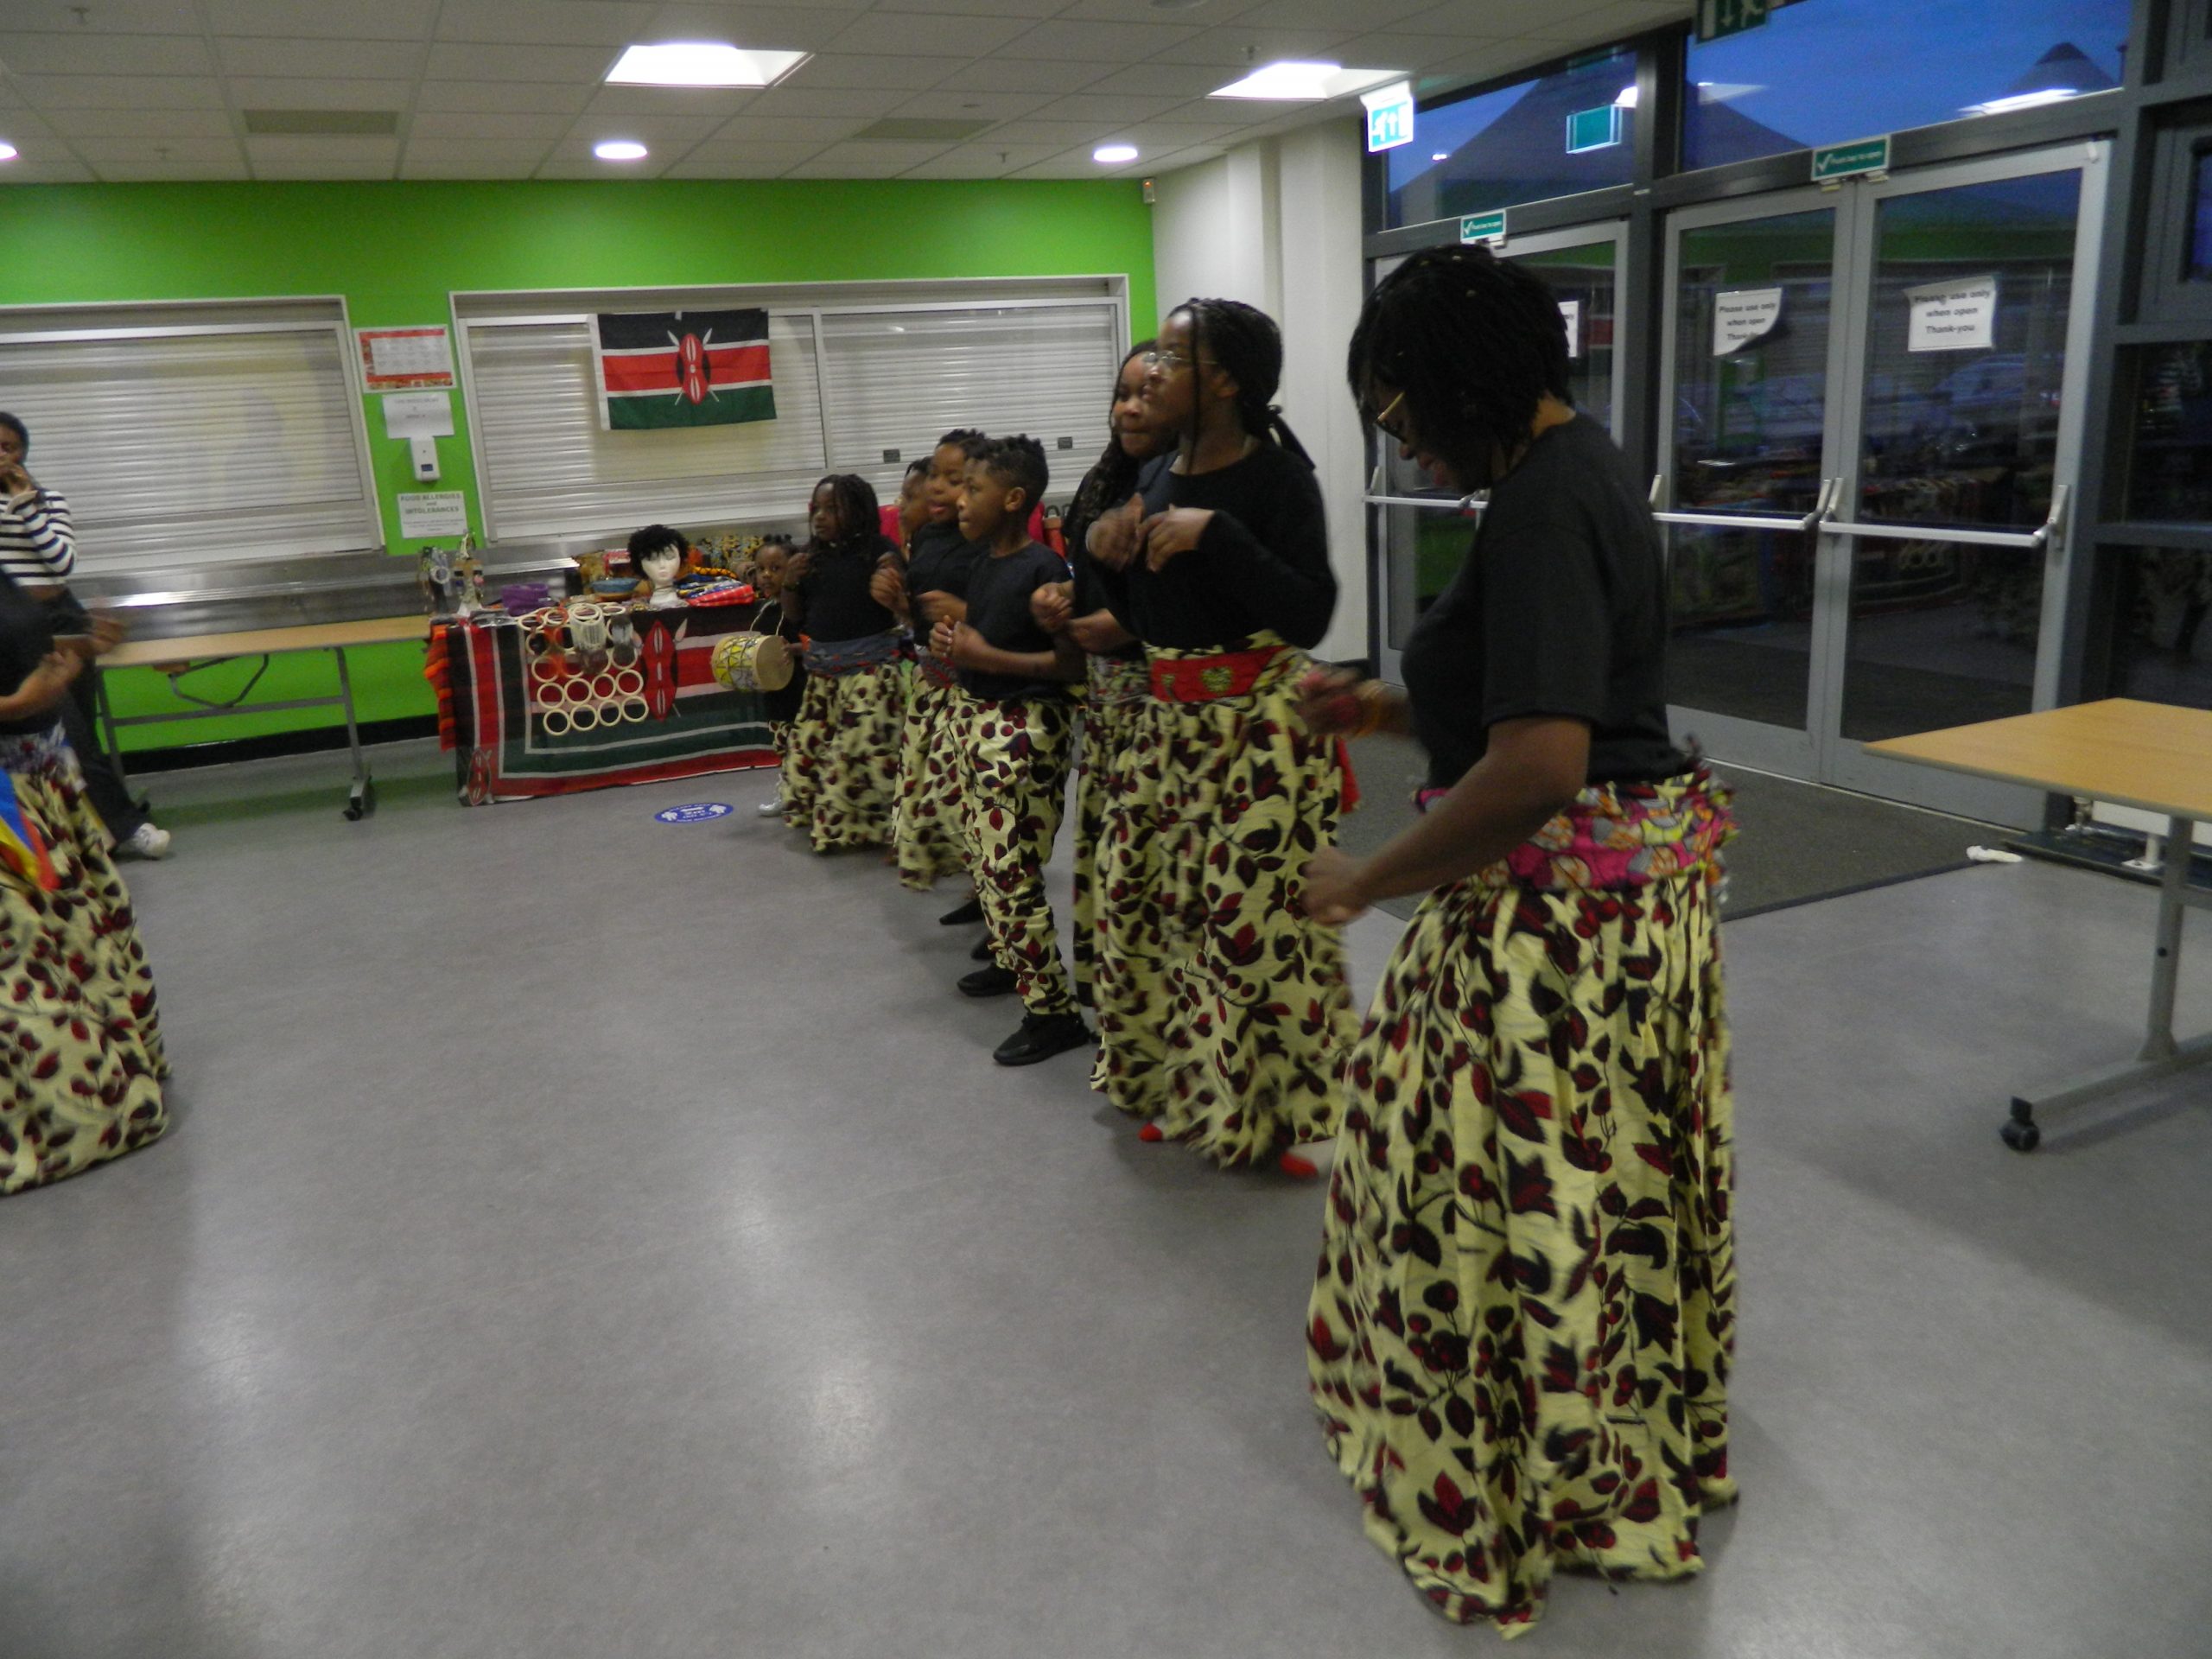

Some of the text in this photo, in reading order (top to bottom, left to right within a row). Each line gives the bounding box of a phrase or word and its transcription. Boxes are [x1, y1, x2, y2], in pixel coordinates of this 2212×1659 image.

[1970, 290, 1990, 299] only
[1761, 302, 1776, 311] only
[1954, 308, 1978, 316] open
[1748, 317, 1765, 326] open
